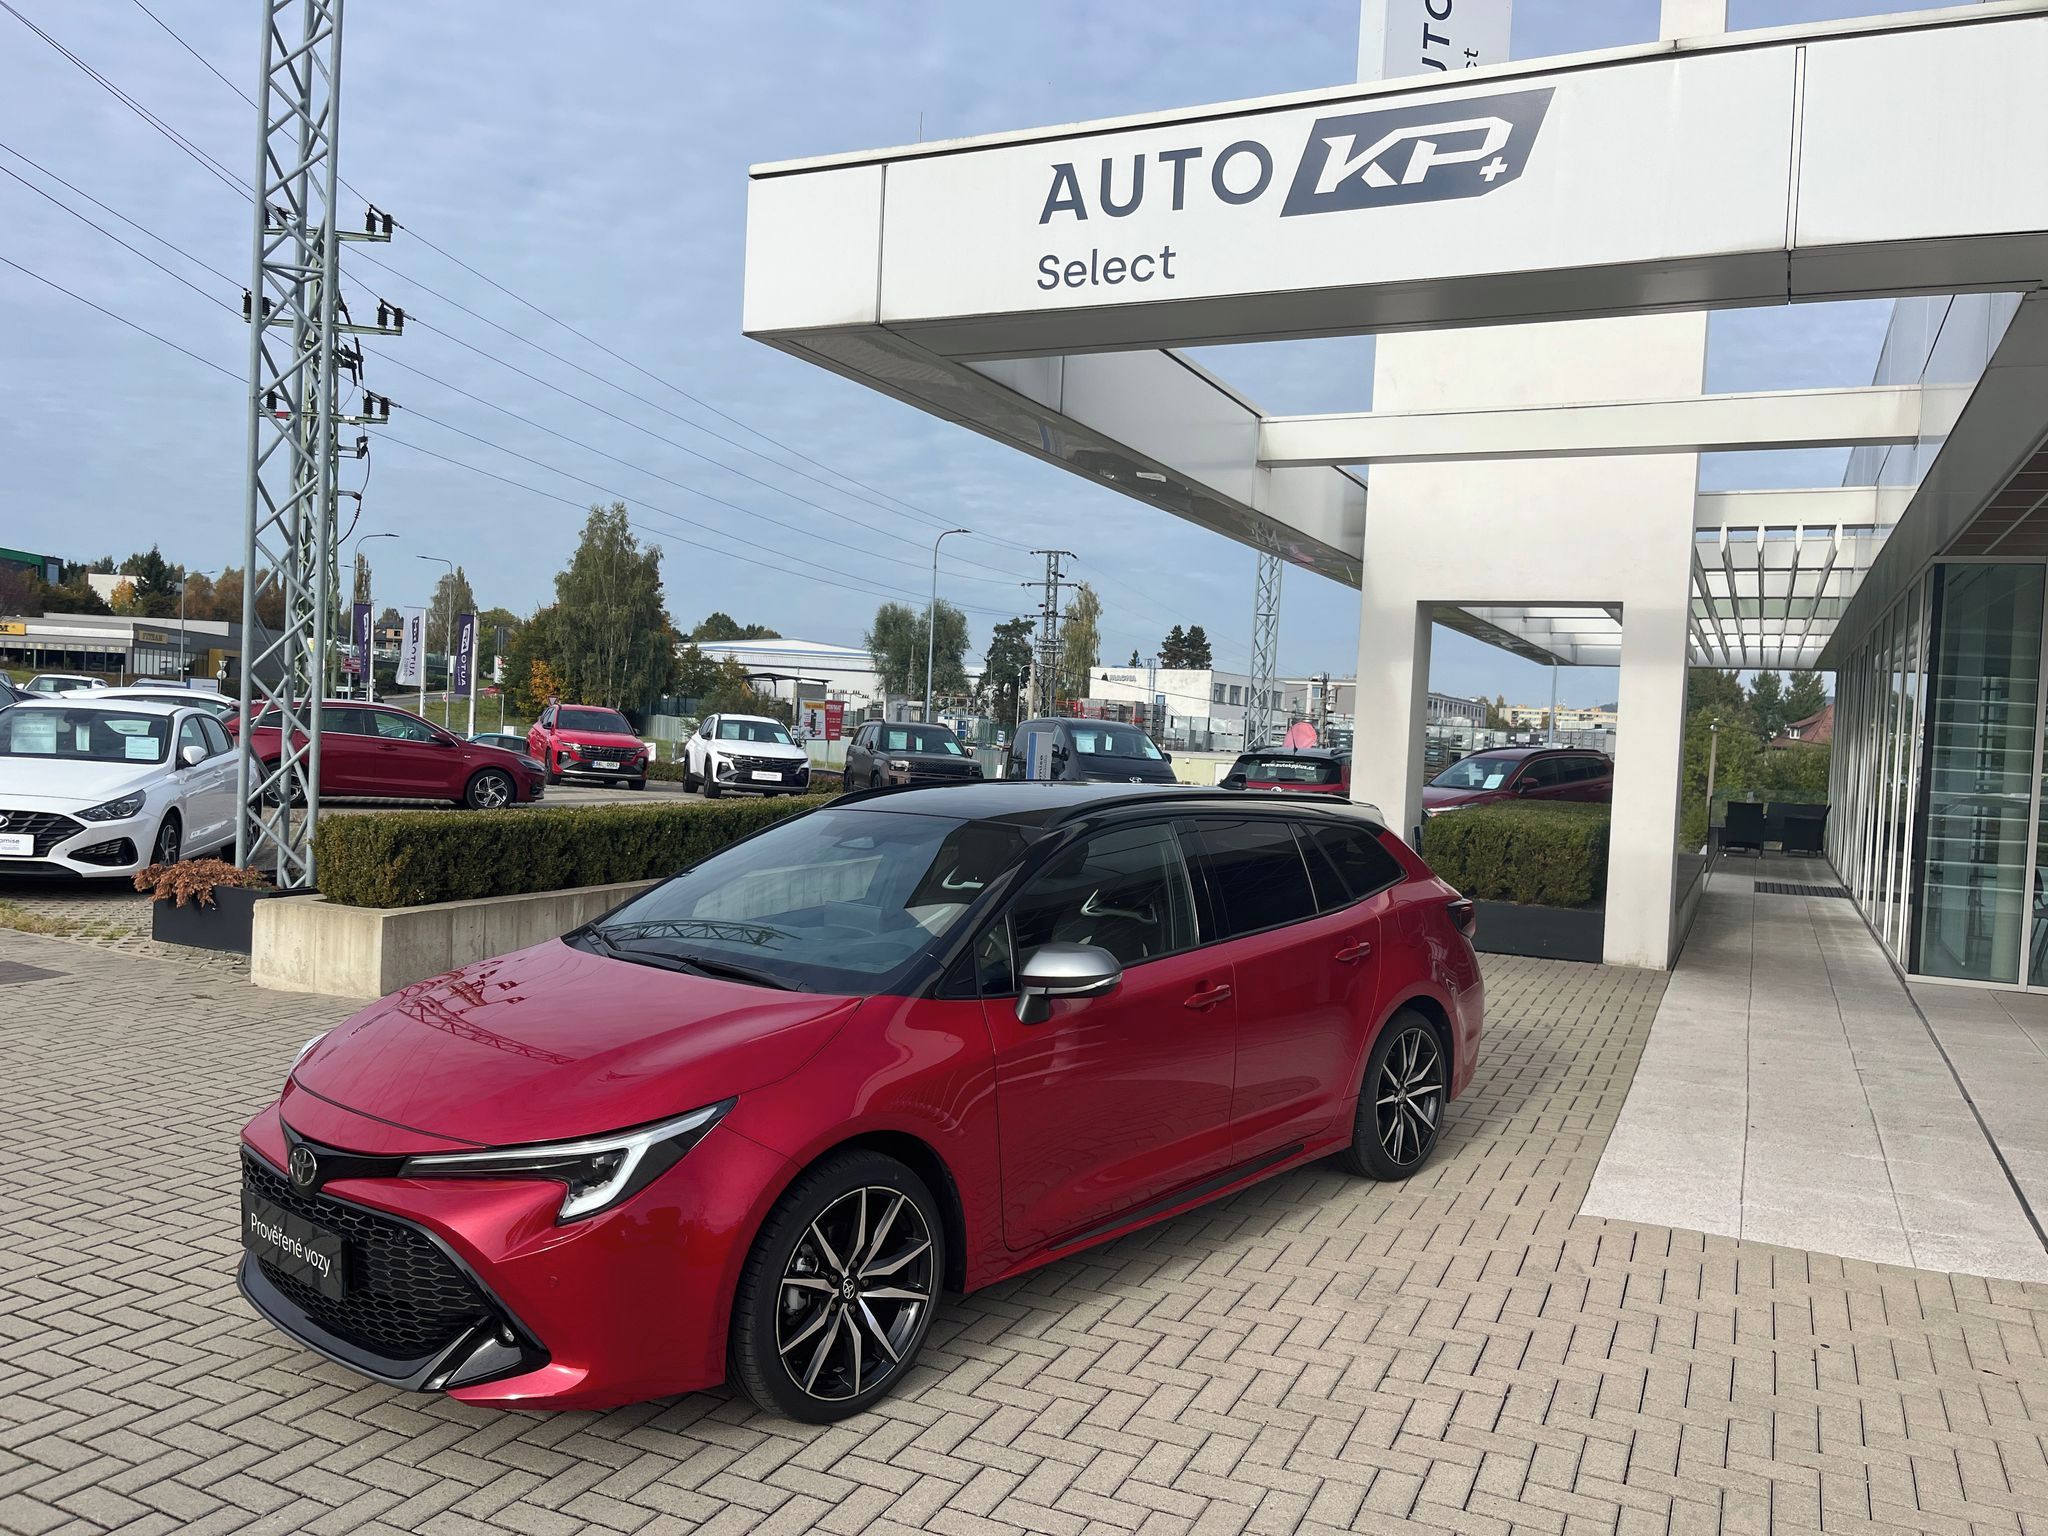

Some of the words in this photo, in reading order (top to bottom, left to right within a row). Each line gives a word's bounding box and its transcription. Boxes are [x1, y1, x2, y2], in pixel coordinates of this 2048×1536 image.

[1038, 139, 1274, 225] AUTO
[1036, 245, 1177, 291] Select
[251, 1212, 303, 1259] Prověřené
[304, 1246, 331, 1278] vozy
